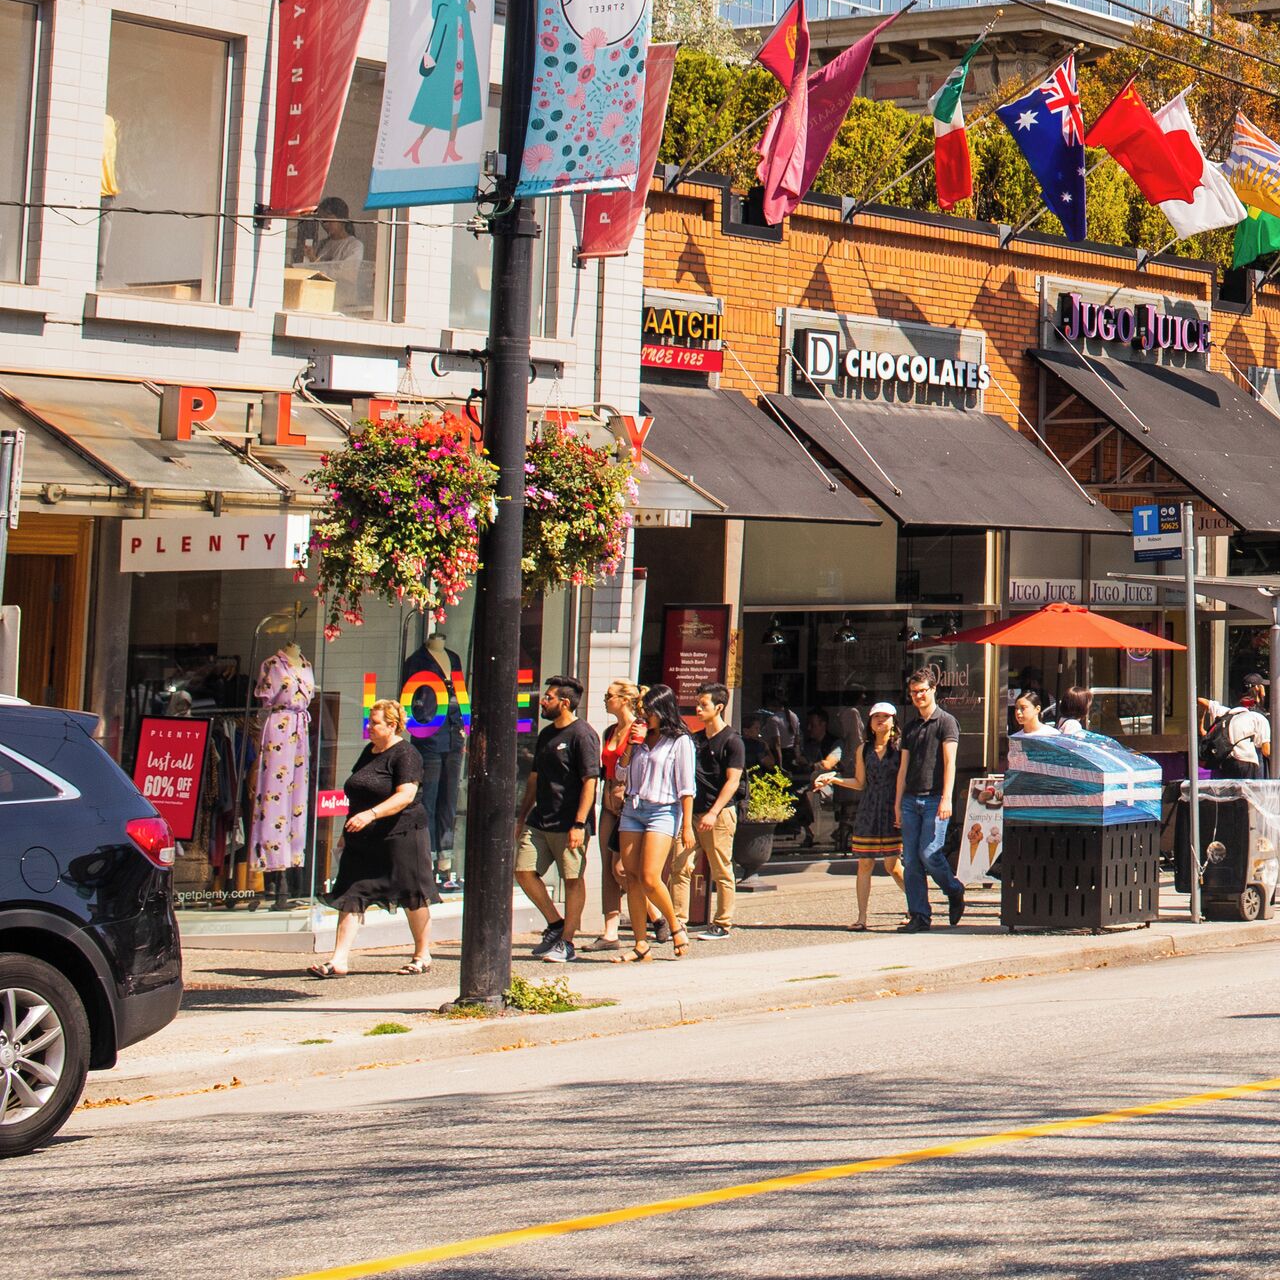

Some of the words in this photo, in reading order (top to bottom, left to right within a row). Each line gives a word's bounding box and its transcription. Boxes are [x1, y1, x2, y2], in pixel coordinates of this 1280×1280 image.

[643, 307, 723, 339] AATCHI
[1065, 292, 1136, 342] JUGO
[1141, 304, 1212, 354] JUICE
[641, 347, 674, 363] INCE
[677, 352, 705, 366] 1925
[846, 349, 990, 390] CHOCOLATES
[1161, 522, 1179, 530] 50625
[1198, 517, 1233, 530] JUICE
[131, 534, 276, 554] PLENTY
[1010, 582, 1040, 601] JUGO
[1043, 582, 1076, 602] JUICE
[1091, 582, 1120, 602] JUGO
[1122, 583, 1153, 602] JUICE
[929, 664, 969, 687] Daniel
[150, 730, 200, 739] PLENTY
[147, 751, 171, 771] last
[171, 753, 194, 771] call
[143, 775, 175, 798] 60%
[176, 777, 193, 792] OFF
[968, 813, 993, 823] Simply
